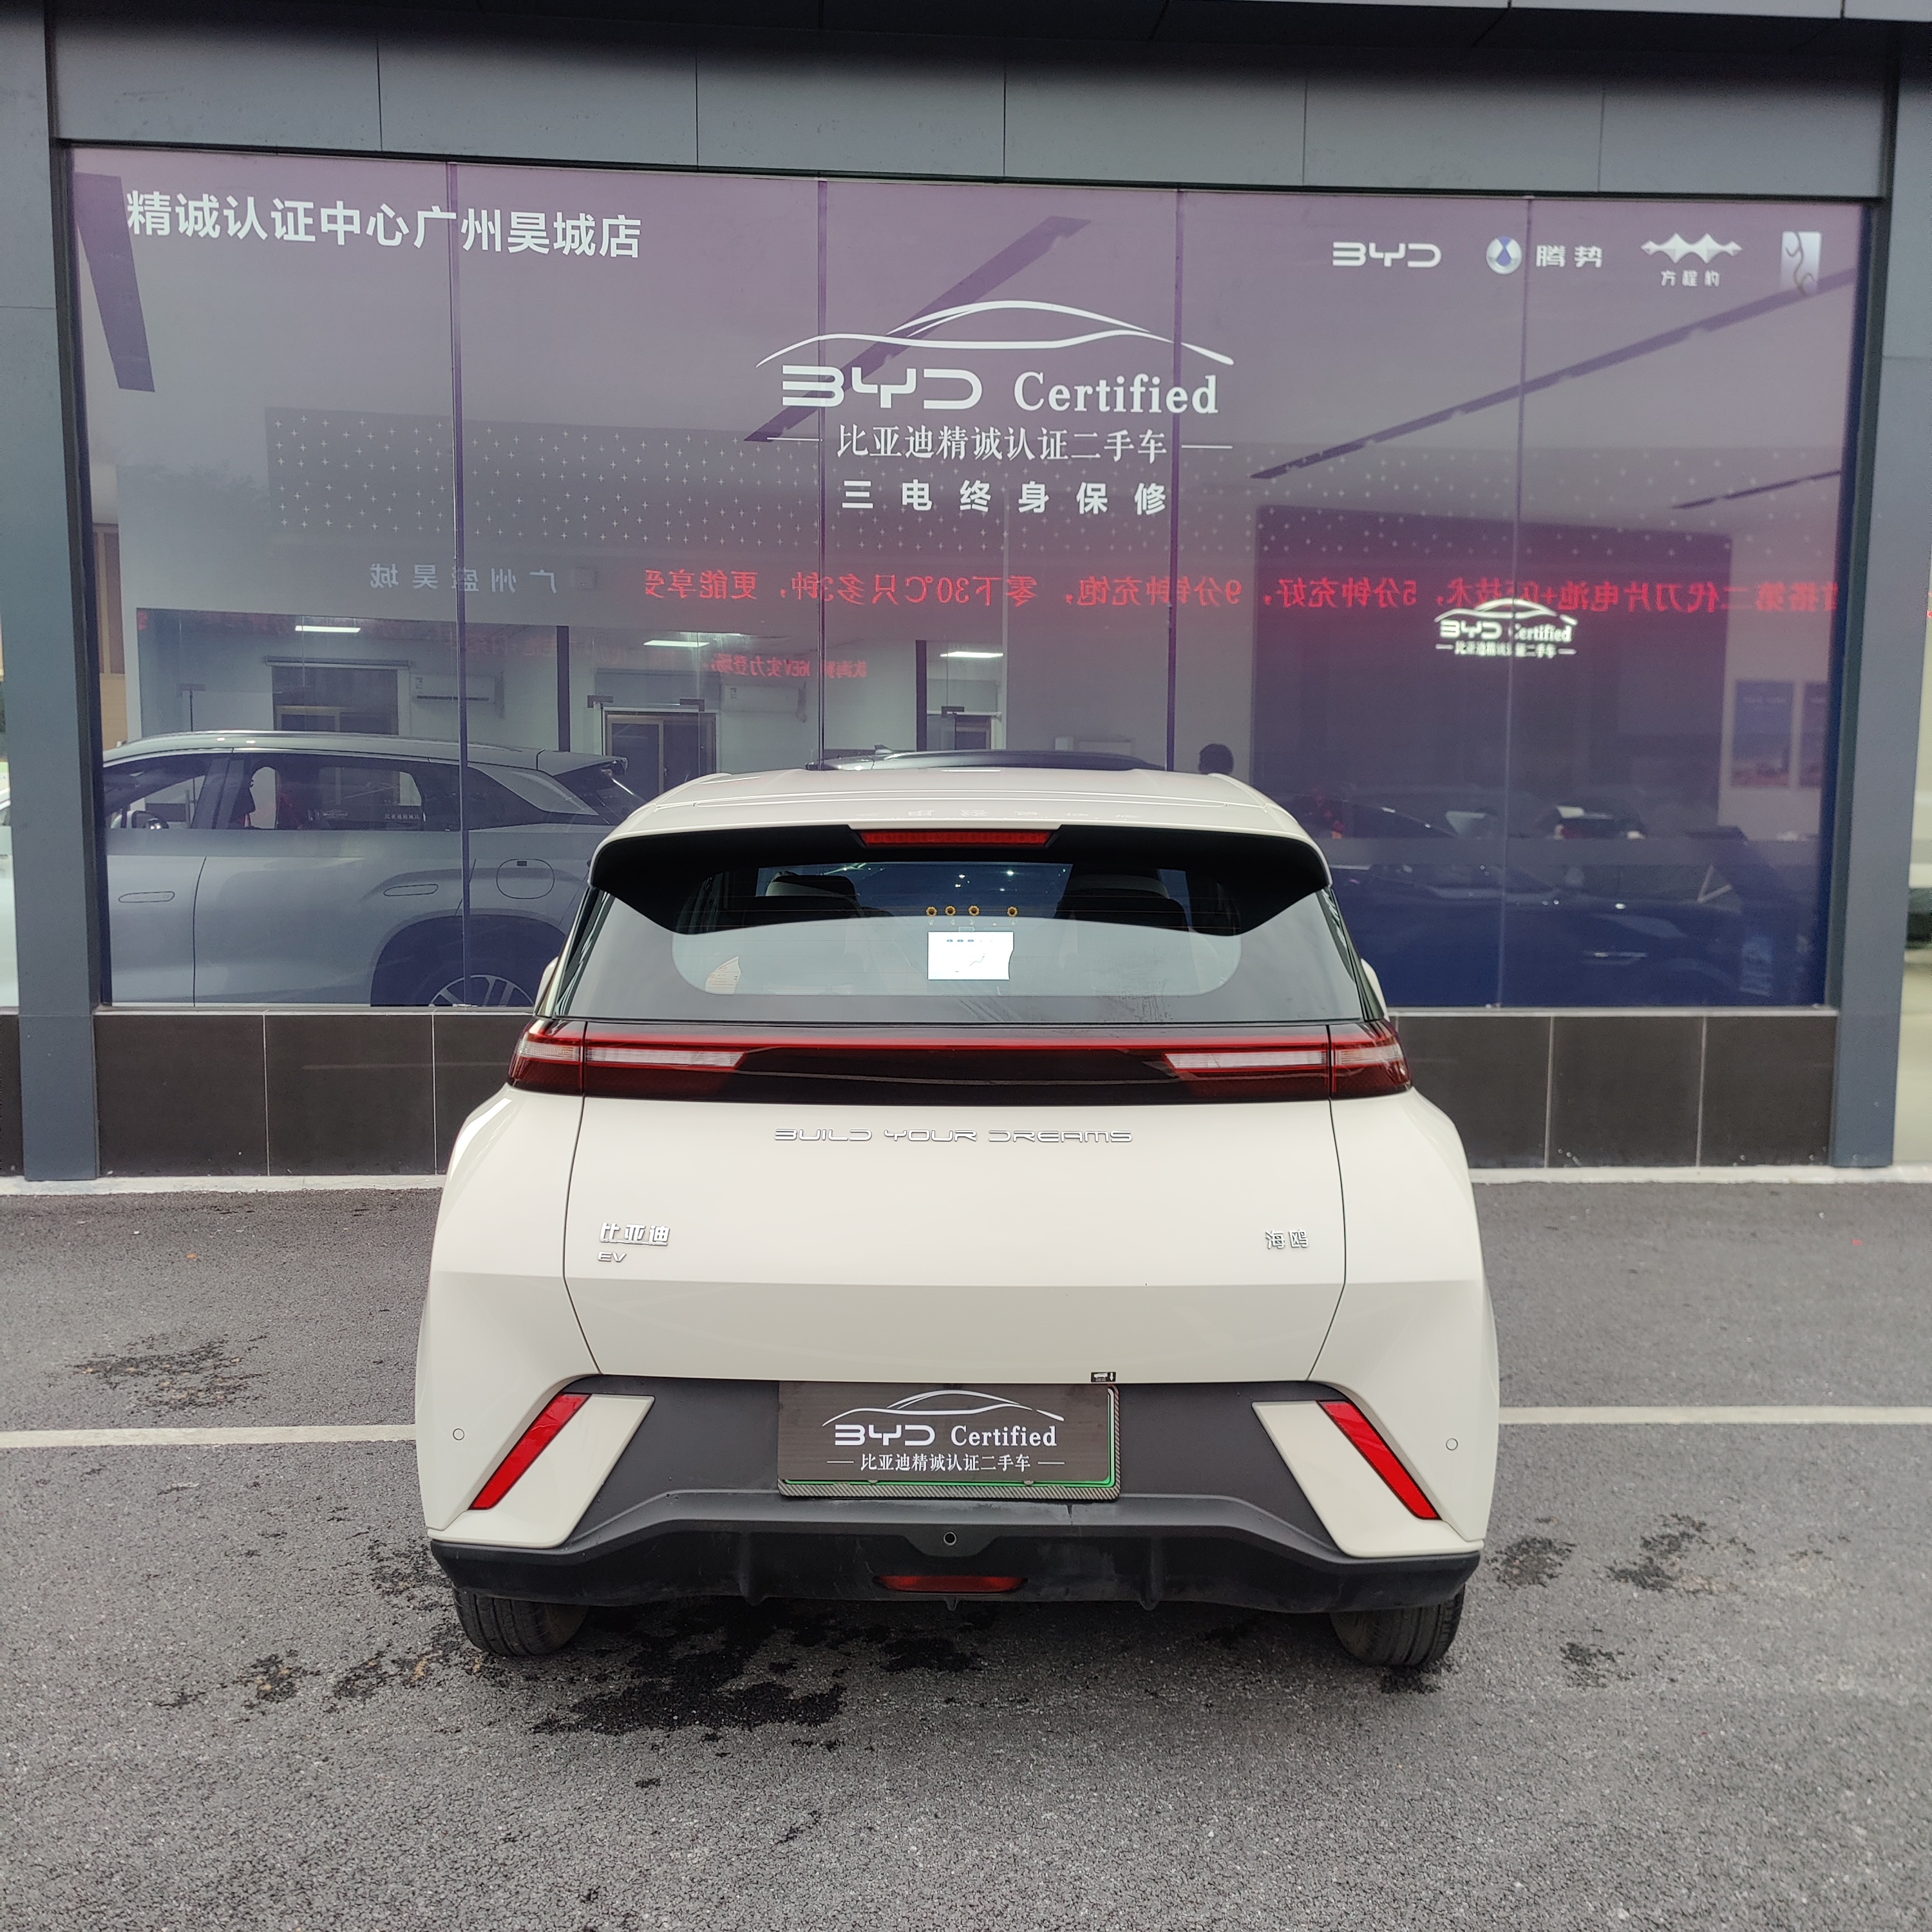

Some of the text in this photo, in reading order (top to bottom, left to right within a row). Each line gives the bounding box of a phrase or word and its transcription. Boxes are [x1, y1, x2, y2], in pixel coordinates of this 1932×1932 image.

[127, 190, 641, 258] 精诚认证中心广州昊城店
[1332, 242, 1441, 267] BYD
[1536, 245, 1602, 267] 腾势
[1661, 270, 1719, 287] 方程豹
[782, 365, 1219, 413] BYD Certified
[837, 424, 1168, 464] 比亚迪精诚认证二手车
[842, 479, 1166, 515] 三电终身保修
[1440, 620, 1502, 639] BYD
[774, 1128, 1133, 1143] BUILD YOUR DREAMS
[600, 1222, 670, 1246] 比亚迪
[1265, 1228, 1309, 1249] 海鸥
[598, 1251, 627, 1263] EV
[835, 1424, 1057, 1446] BYD Certified
[860, 1454, 1030, 1472] 比亚迪精诚认证二手车
